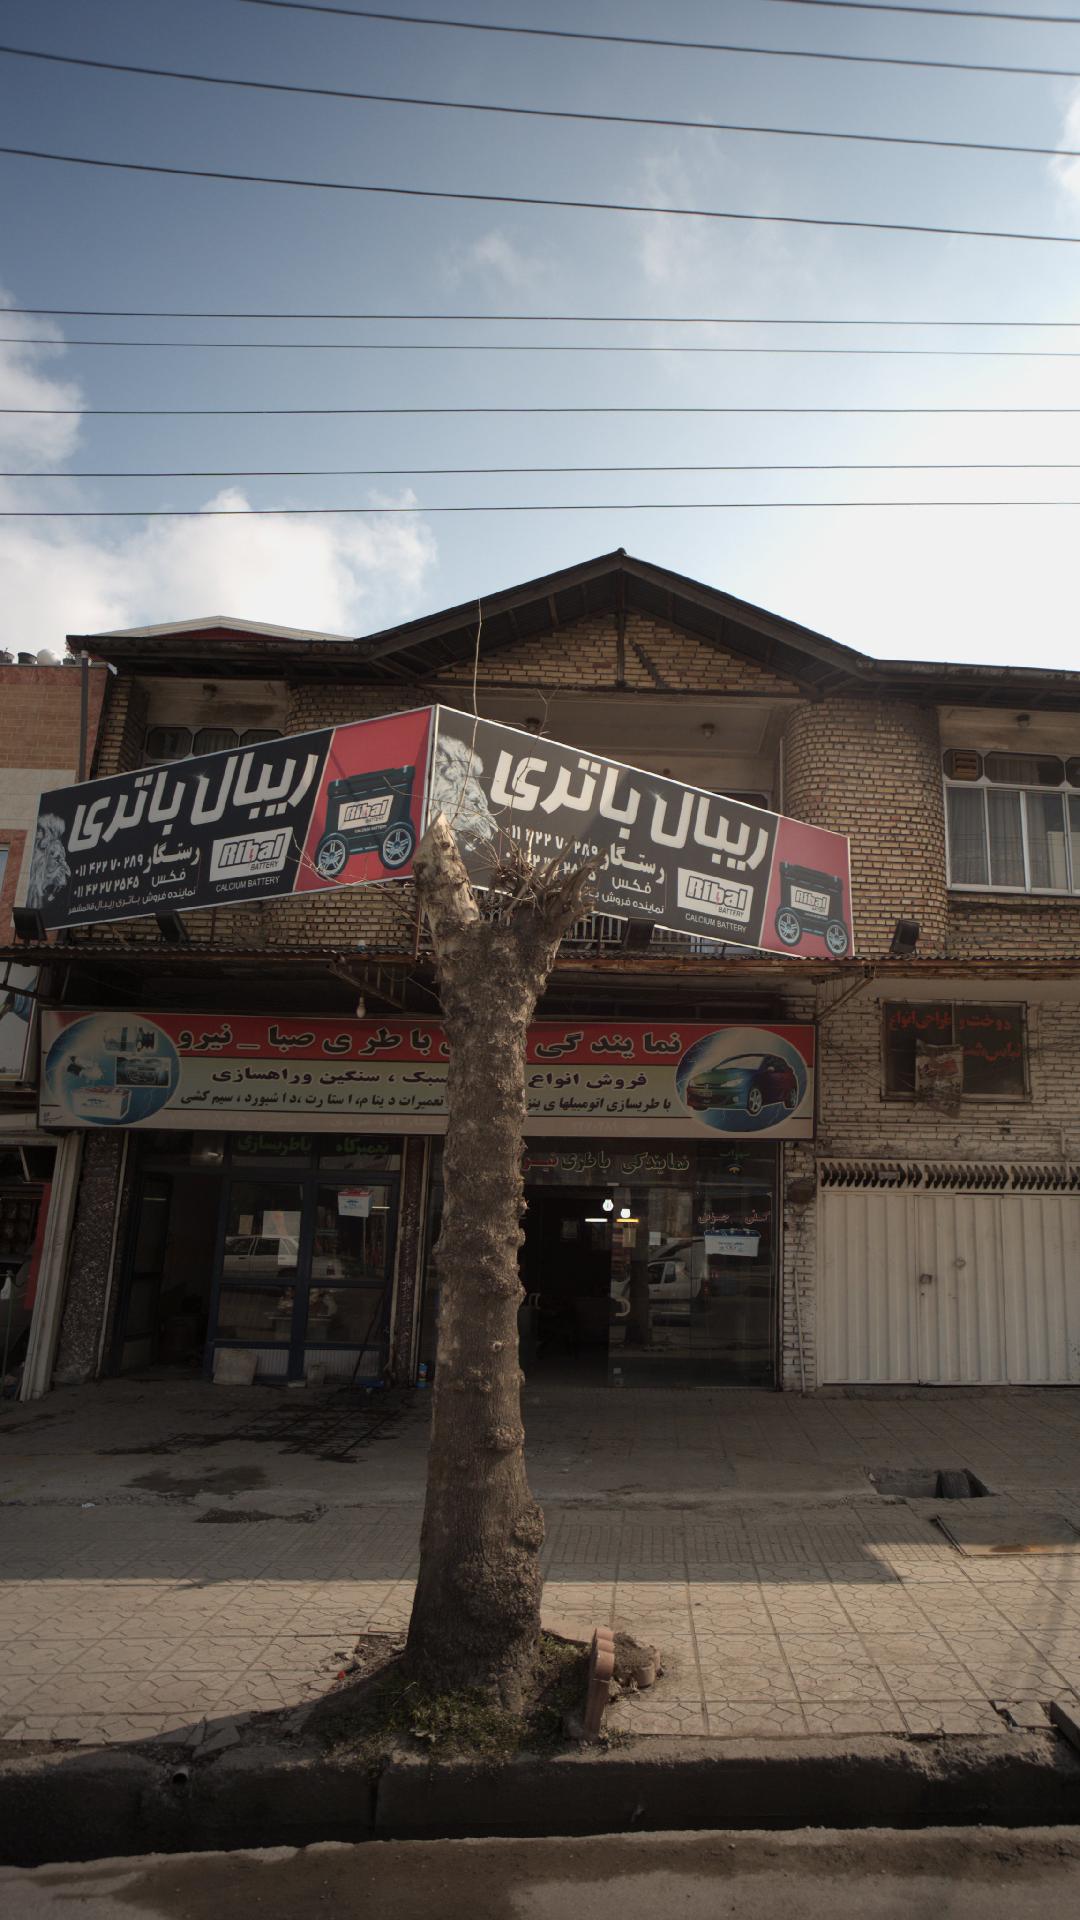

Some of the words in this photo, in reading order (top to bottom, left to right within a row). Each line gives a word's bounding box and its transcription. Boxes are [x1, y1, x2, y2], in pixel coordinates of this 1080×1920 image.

[190, 752, 319, 826] ریبال
[490, 750, 641, 839] باتری
[67, 771, 186, 853] باتری
[650, 791, 769, 870] ریبال
[143, 842, 201, 874] رستگار
[218, 833, 285, 868] Ribal
[250, 860, 279, 871] BATTERY
[600, 843, 665, 884] رستگار
[151, 868, 187, 888] فکس
[215, 880, 247, 893] CALCIUM
[247, 875, 281, 888] BATTERY
[611, 875, 652, 894] فکس
[142, 891, 166, 904] فروش
[167, 887, 196, 900] نماینده
[601, 890, 631, 906] فروش
[685, 875, 748, 911] Ribal
[632, 900, 665, 914] نماینده
[718, 906, 744, 918] BATTERY
[685, 913, 715, 927] CALCIUM
[716, 919, 747, 934] BATTERY
[176, 1023, 233, 1051] نیرو
[268, 1024, 316, 1052] صبا
[319, 1070, 380, 1085] سنگین
[527, 1072, 579, 1089] انواع
[585, 1072, 648, 1090] فروش
[398, 1095, 444, 1110] تعمیرات
[561, 1150, 611, 1173] باطری
[622, 1151, 690, 1175] نمایندگی
